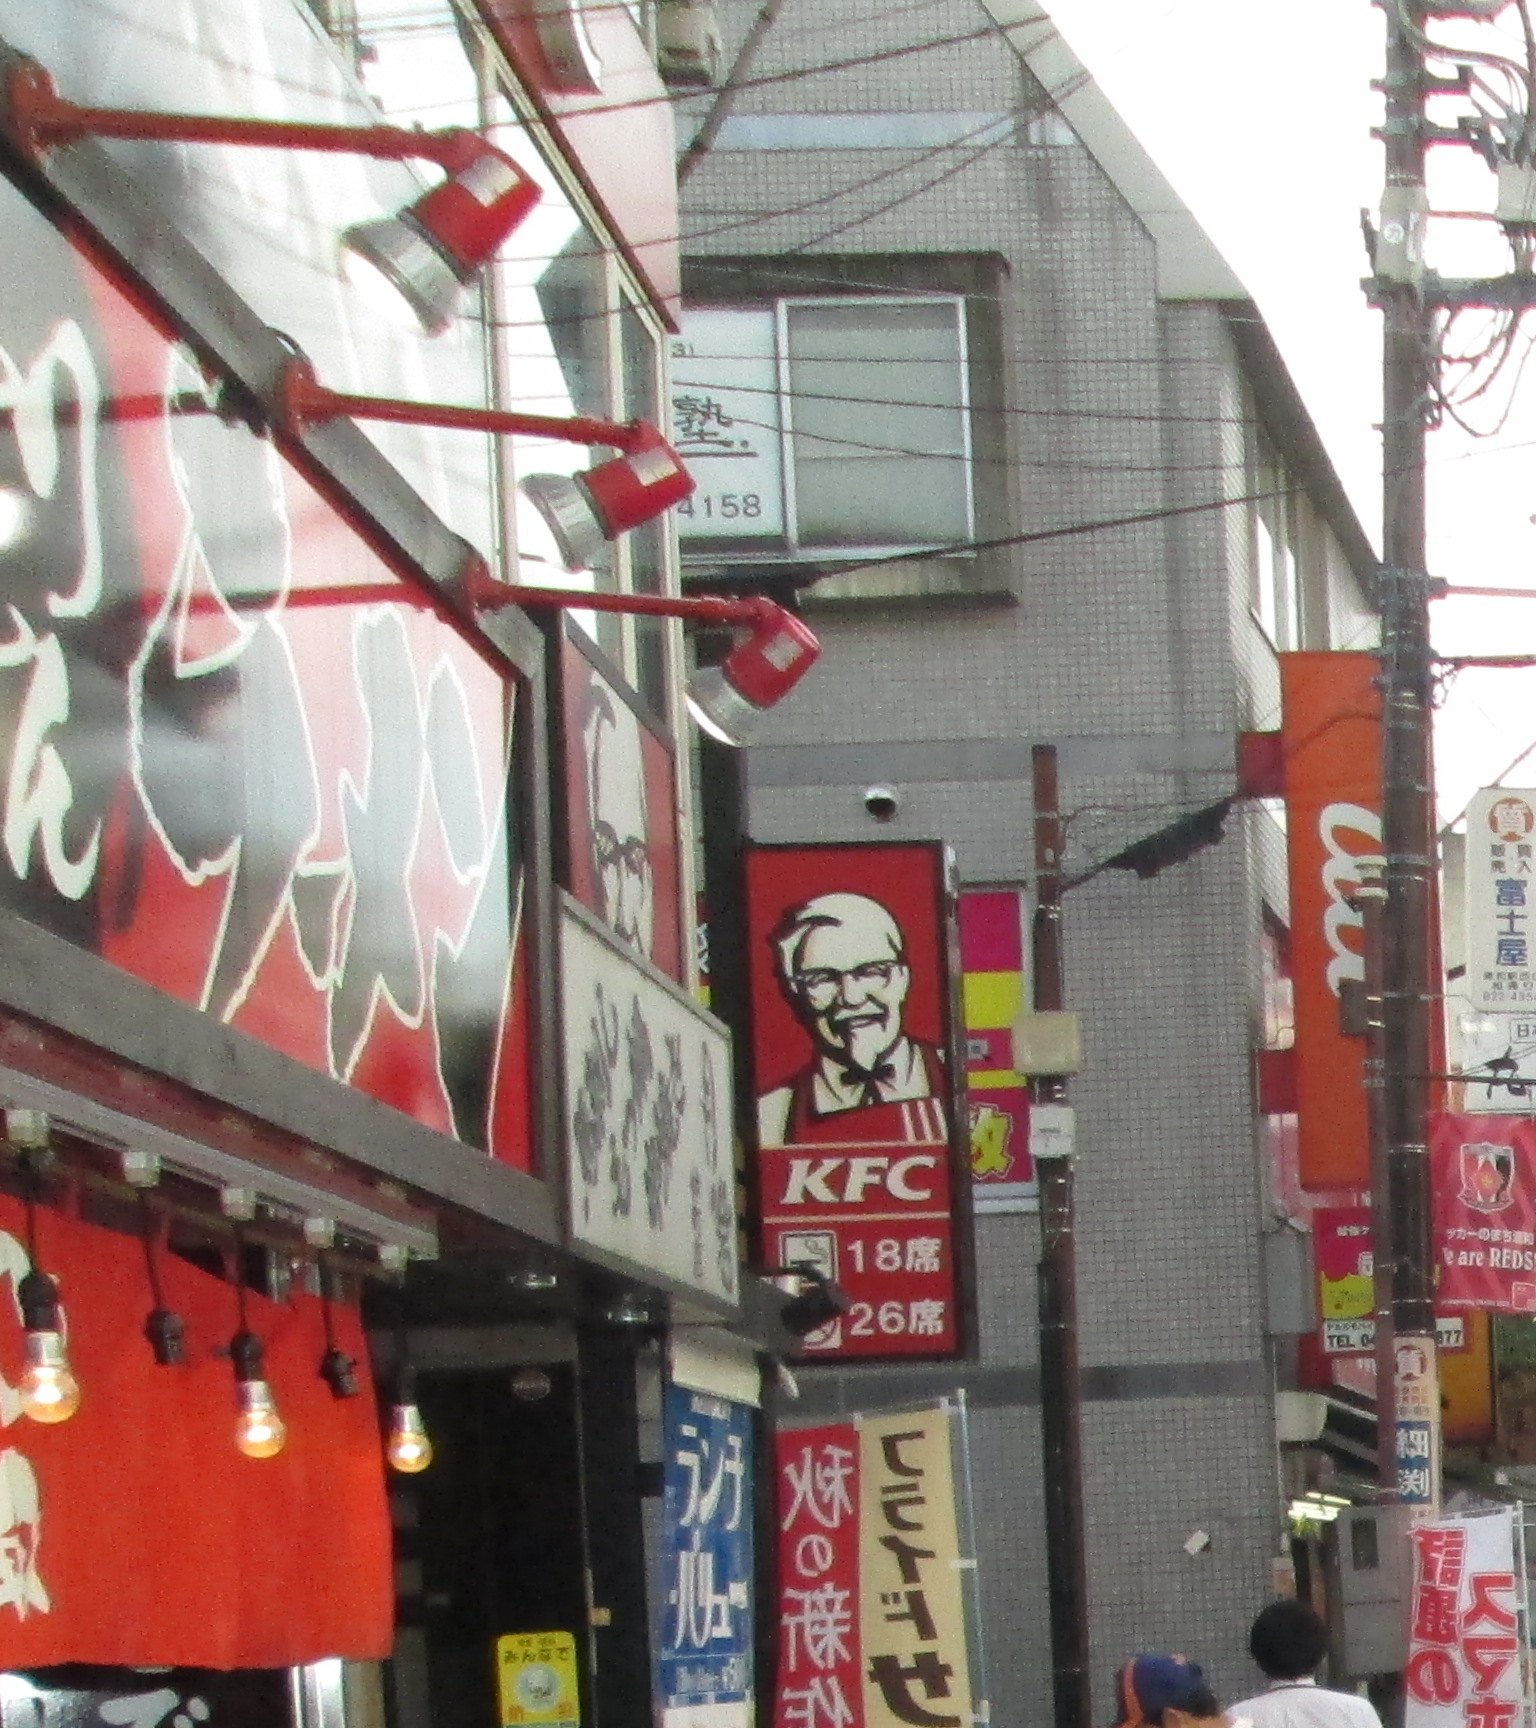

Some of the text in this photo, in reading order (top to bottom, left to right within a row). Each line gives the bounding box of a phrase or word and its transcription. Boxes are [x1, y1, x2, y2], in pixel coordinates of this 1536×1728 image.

[678, 494, 762, 518] 4158
[1496, 878, 1528, 966] 富士屋
[781, 1156, 936, 1205] KFC
[847, 1238, 941, 1274] 18席
[1457, 1251, 1485, 1266] are
[850, 1300, 946, 1337] 26席
[1327, 1334, 1354, 1349] TEL
